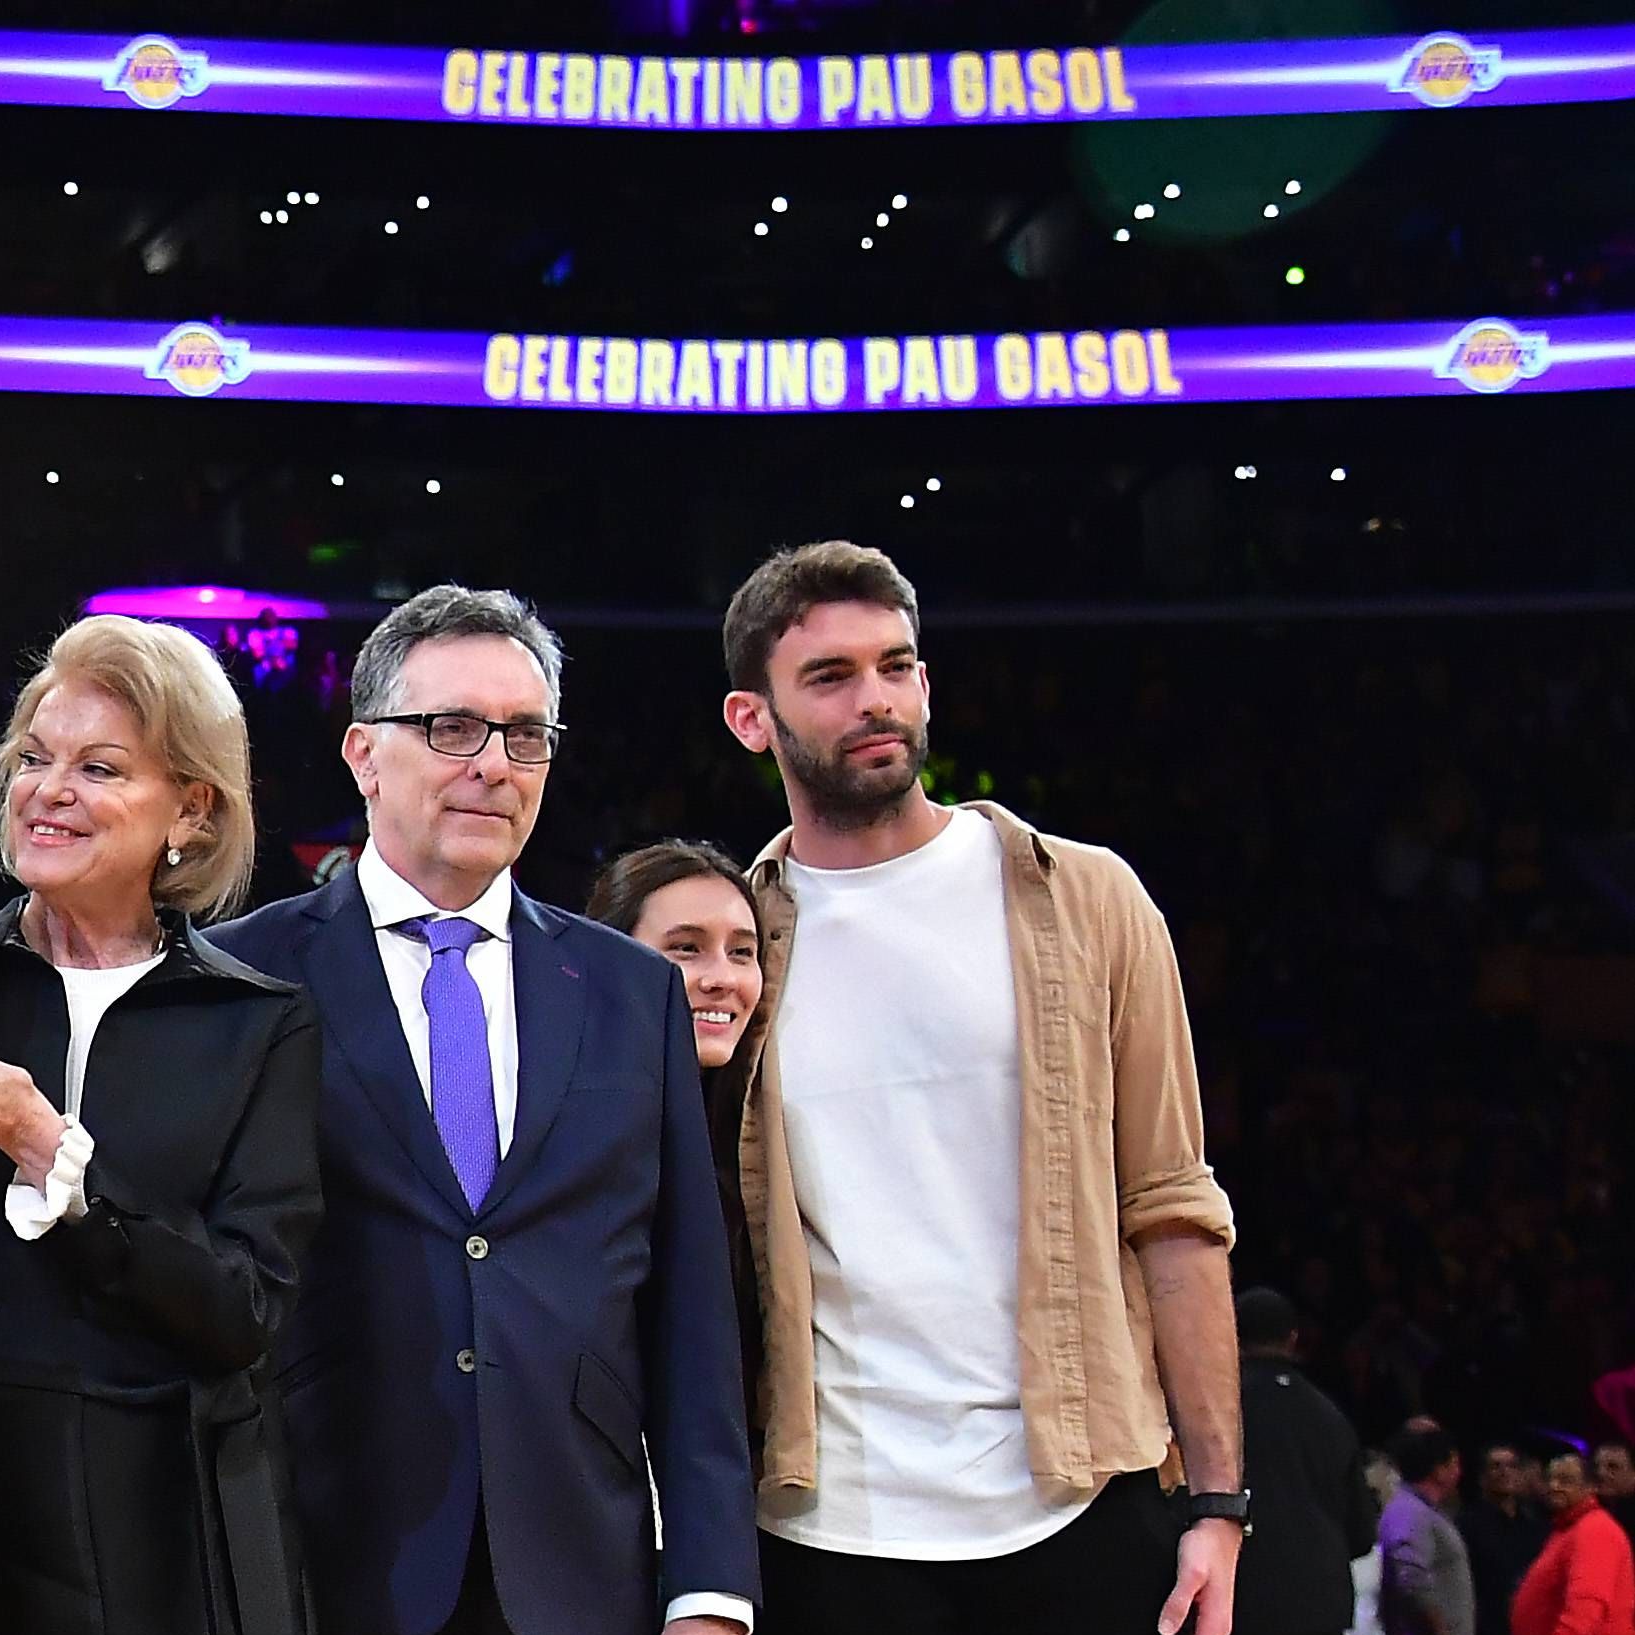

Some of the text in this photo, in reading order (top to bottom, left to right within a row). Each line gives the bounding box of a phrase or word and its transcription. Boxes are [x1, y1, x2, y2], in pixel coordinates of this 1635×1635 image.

[441, 46, 1138, 126] CELEBRATING PAU GASOL
[482, 327, 1183, 407] CELEBRATING PAU GASOL
